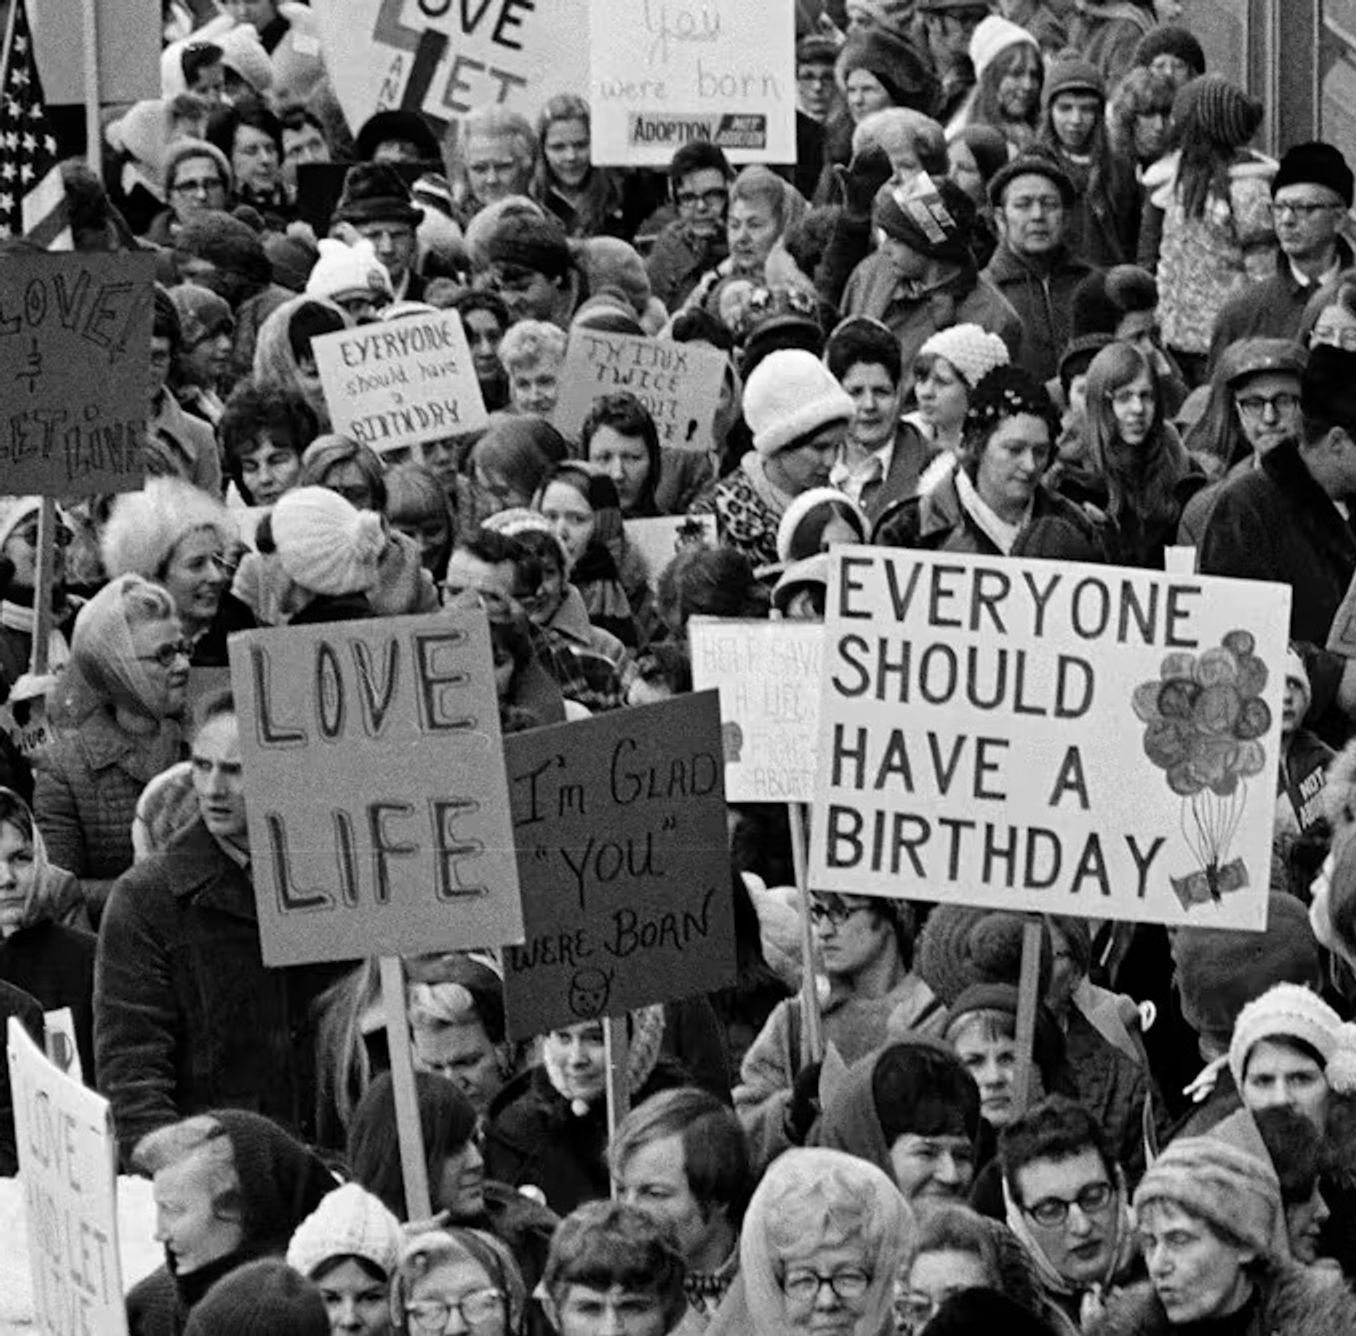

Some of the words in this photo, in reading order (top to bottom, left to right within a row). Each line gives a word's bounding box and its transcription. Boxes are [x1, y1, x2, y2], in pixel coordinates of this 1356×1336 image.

[600, 77, 669, 101] were
[697, 57, 783, 101] born
[633, 116, 711, 142] ADOPTION
[0, 410, 67, 463] ET
[839, 555, 1203, 649] EVERYONE
[250, 629, 478, 749] LOVE
[831, 633, 1096, 719] SHOULD
[513, 754, 587, 828] I'm
[831, 723, 1011, 801] HAVE
[1048, 745, 1091, 810] A
[264, 799, 490, 915] LIFE
[825, 804, 1167, 900] BIRTHDAY
[603, 887, 716, 958] BORN
